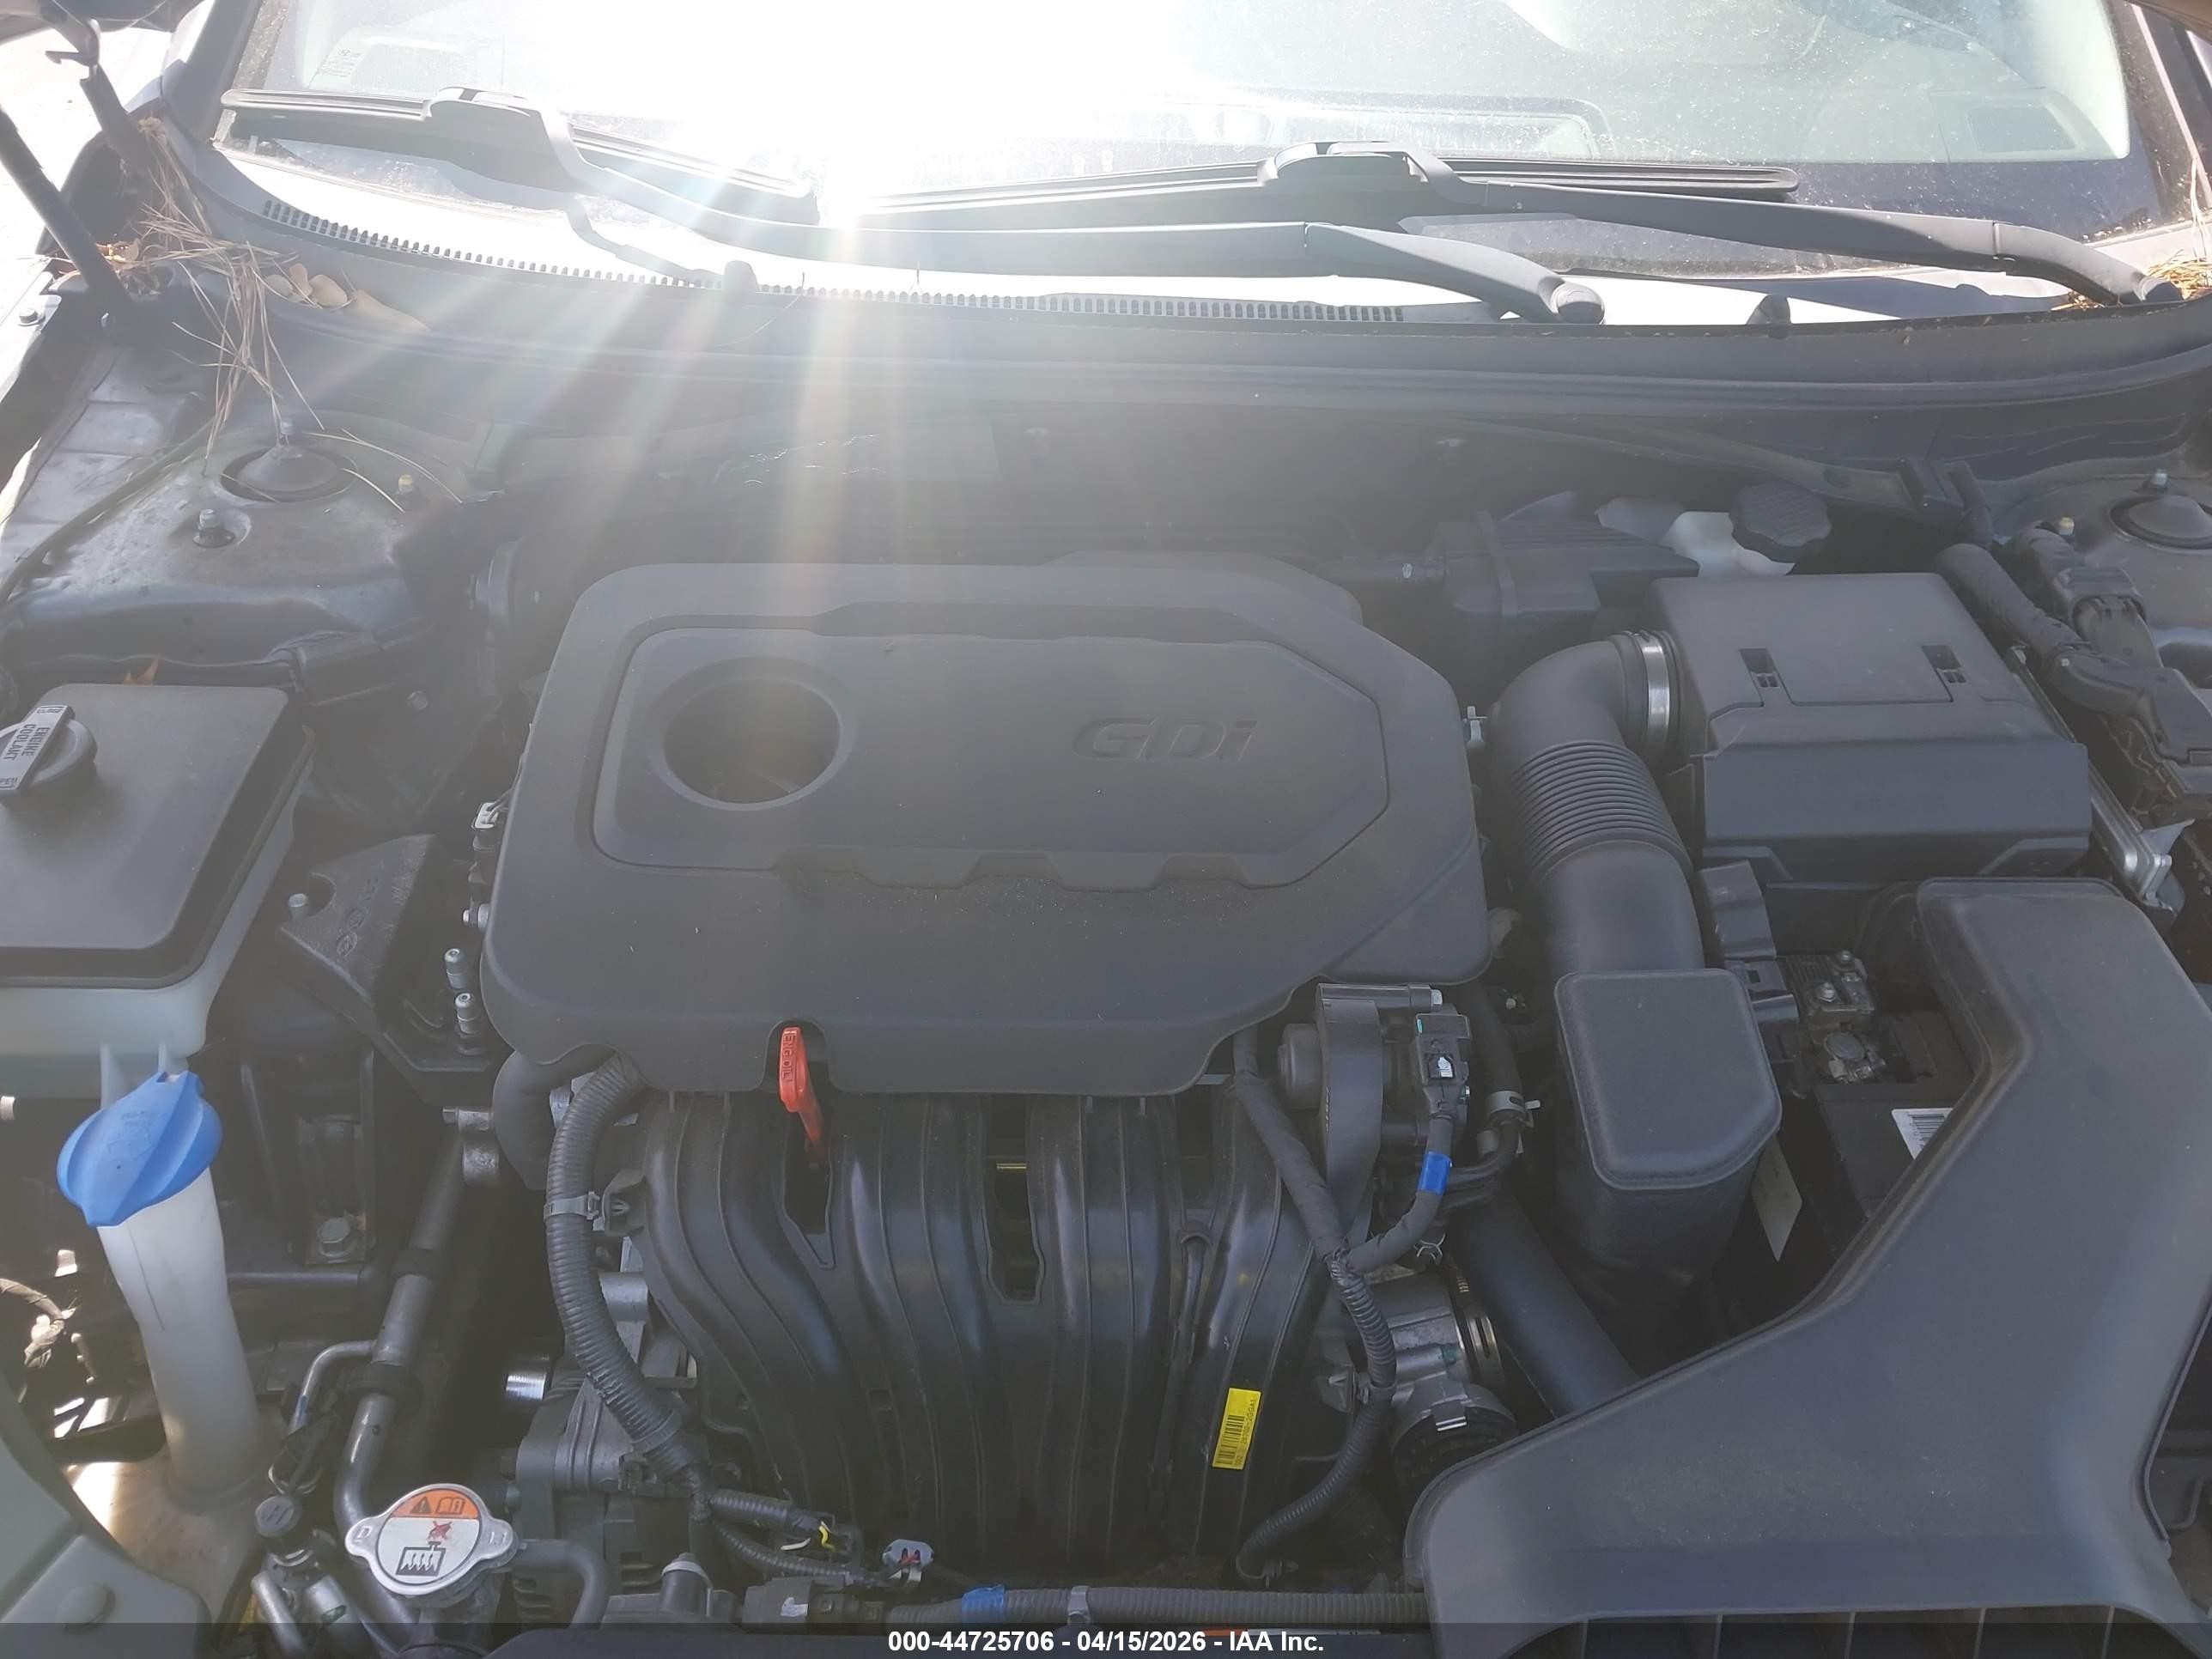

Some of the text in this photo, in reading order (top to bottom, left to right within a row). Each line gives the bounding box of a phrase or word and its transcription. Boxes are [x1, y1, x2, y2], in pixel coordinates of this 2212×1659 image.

[3, 724, 36, 761] COOLANT
[782, 1034, 793, 1079] ENG OIL
